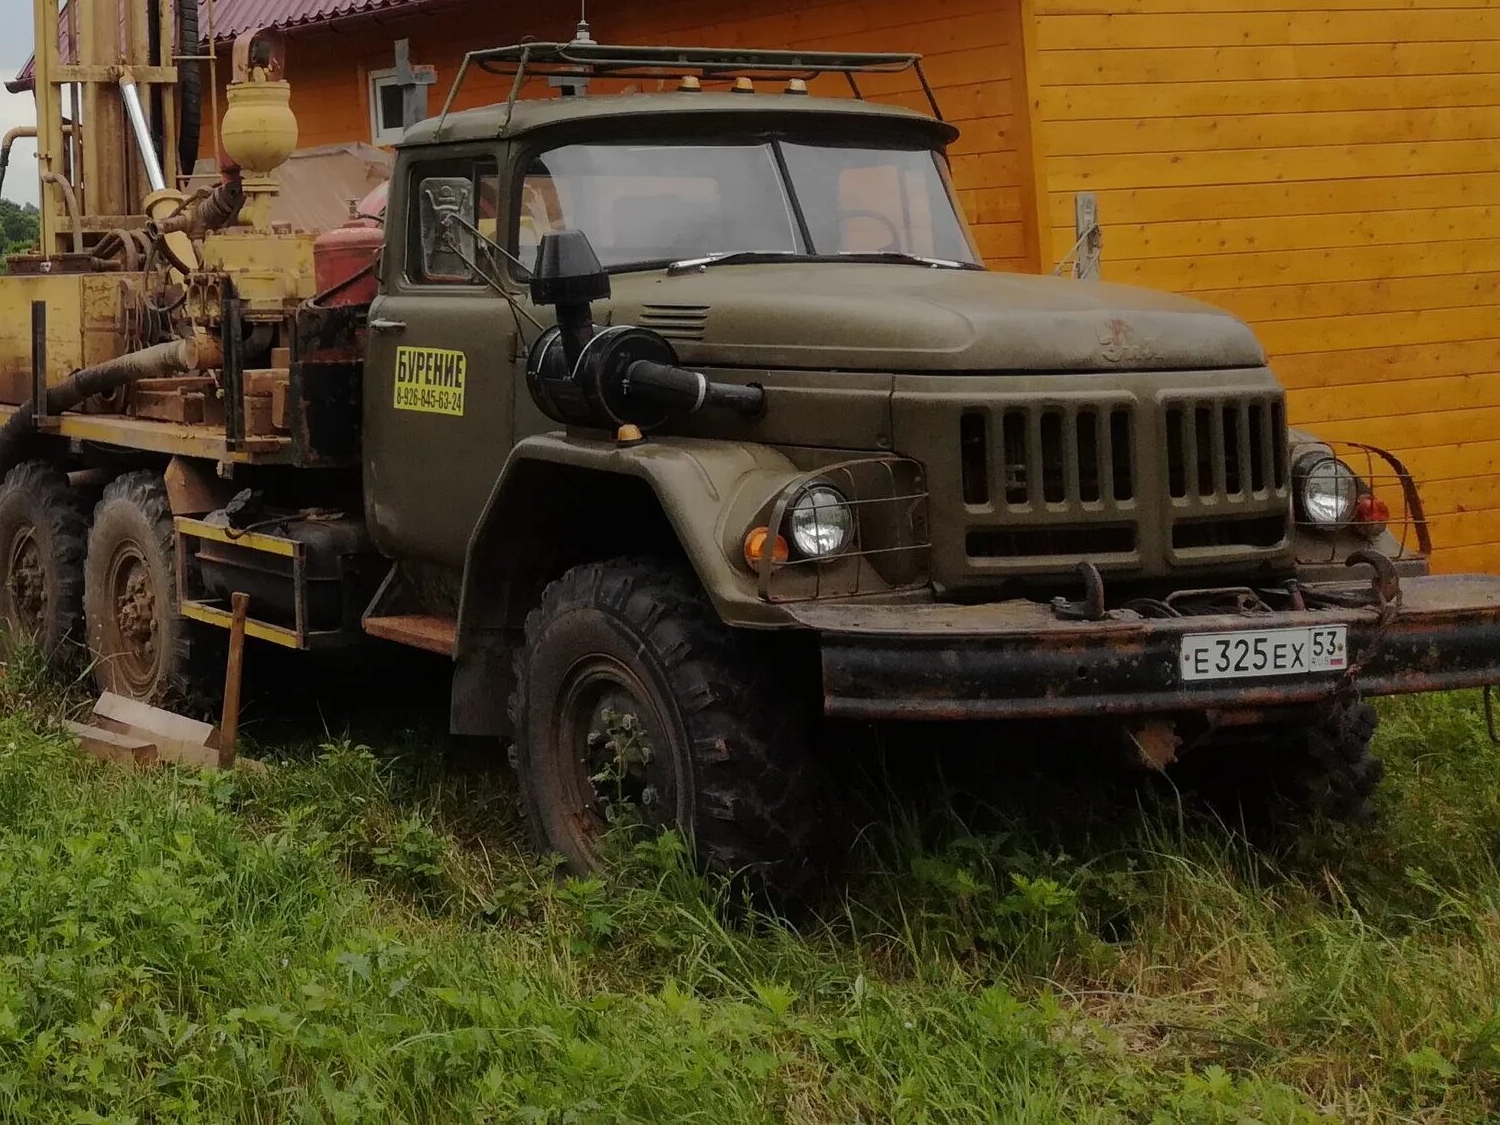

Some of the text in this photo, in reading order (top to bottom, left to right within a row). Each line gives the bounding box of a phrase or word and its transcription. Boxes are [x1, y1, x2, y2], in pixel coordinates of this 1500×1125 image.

[398, 350, 463, 388] БУРЕНИЕ
[396, 387, 462, 411] 8-926-845-63-24
[1313, 631, 1337, 656] 53
